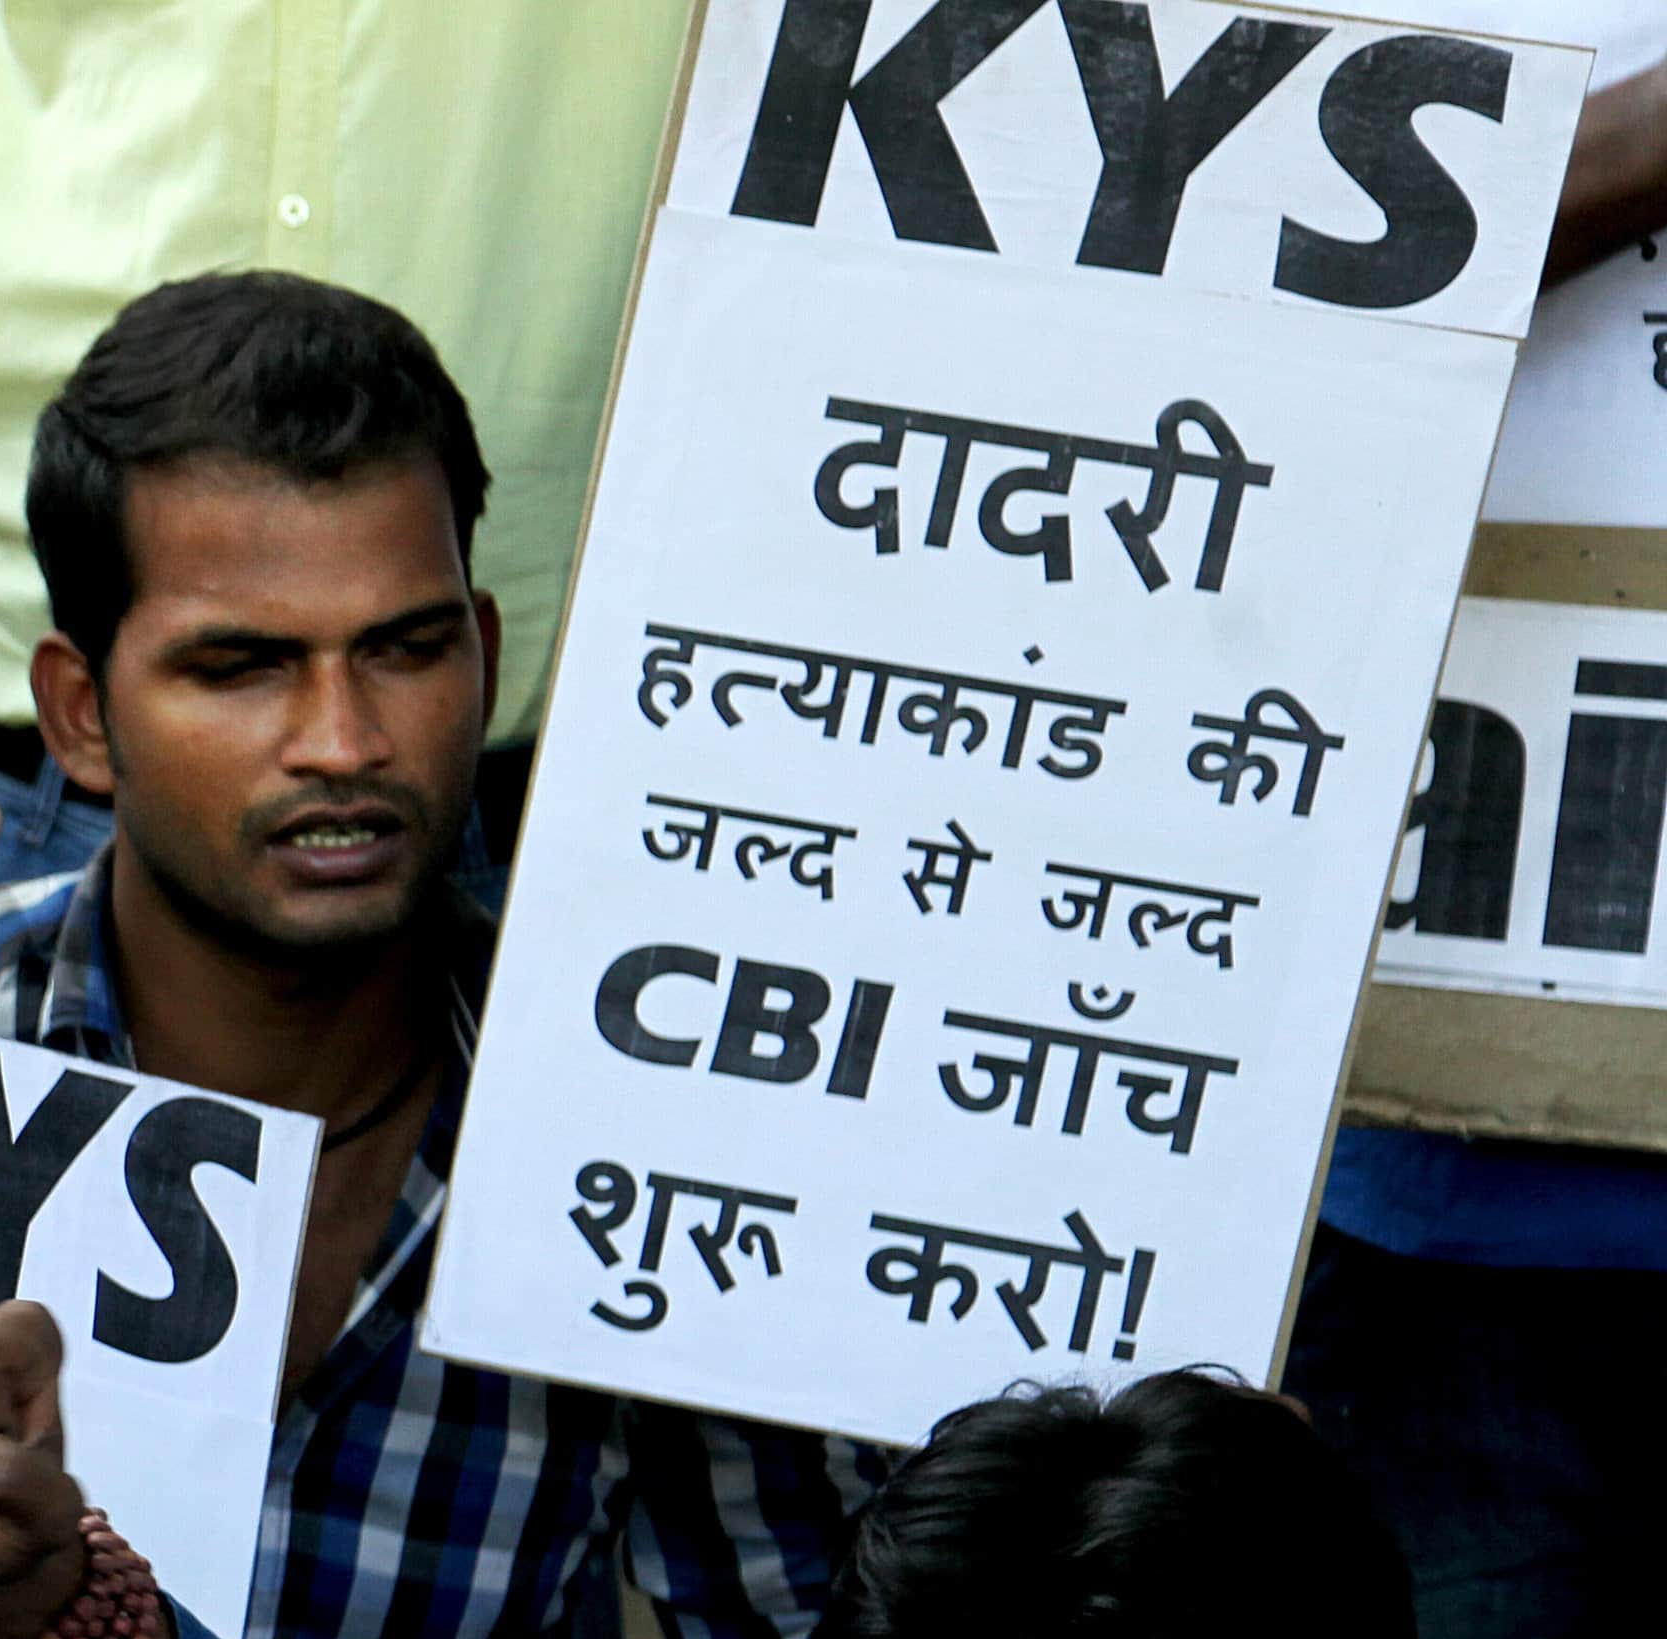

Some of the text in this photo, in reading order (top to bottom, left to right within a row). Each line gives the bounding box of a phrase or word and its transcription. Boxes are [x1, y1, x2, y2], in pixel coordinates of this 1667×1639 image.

[730, 0, 1514, 308] KYS
[814, 398, 1274, 593] दादरी
[636, 622, 1344, 817] हत्याकांड की
[641, 793, 1260, 968] जल्द से जल्द
[593, 943, 1238, 1155] CBI जाँच
[567, 1160, 1156, 1361] शुरू करो!
